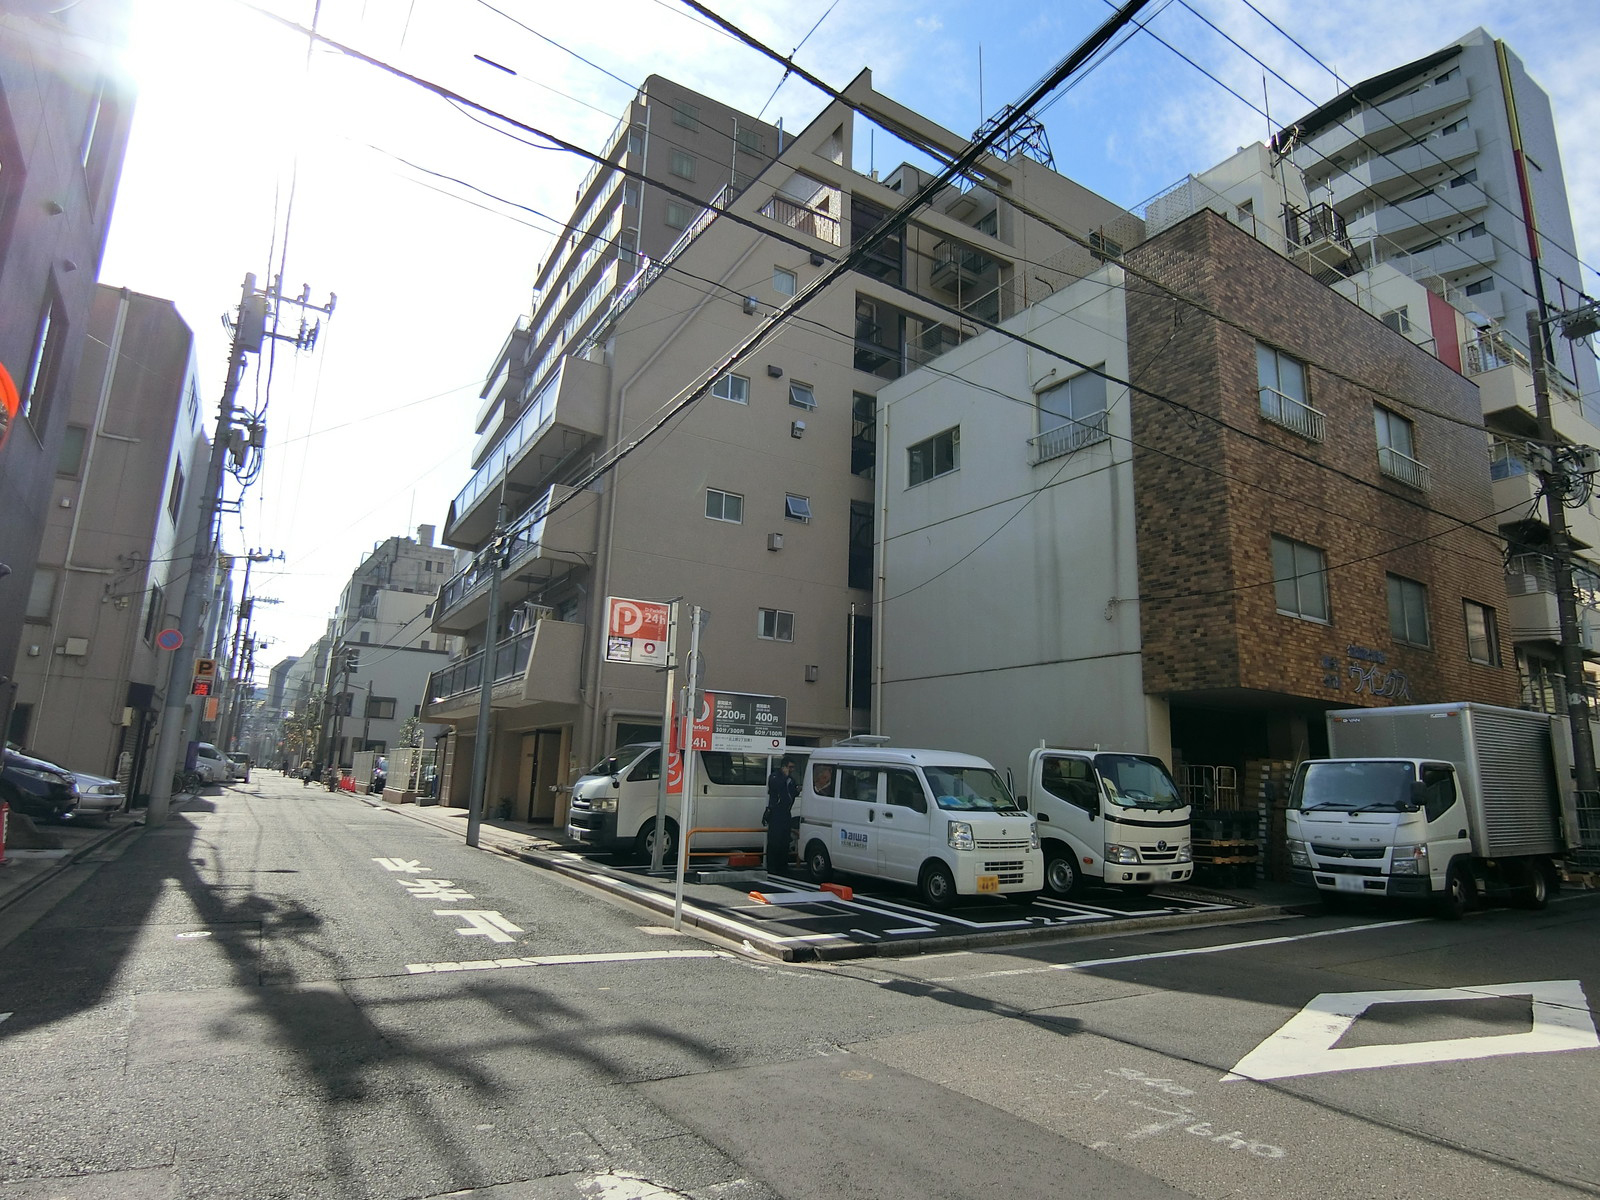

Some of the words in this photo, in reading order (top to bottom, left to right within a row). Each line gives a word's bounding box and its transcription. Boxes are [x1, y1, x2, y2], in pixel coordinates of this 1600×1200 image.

[644, 612, 666, 624] 24h
[199, 661, 213, 674] P
[716, 709, 746, 721] 2200円
[755, 712, 779, 723] 400円
[691, 737, 707, 748] 4h
[371, 857, 524, 942] 止まれ
